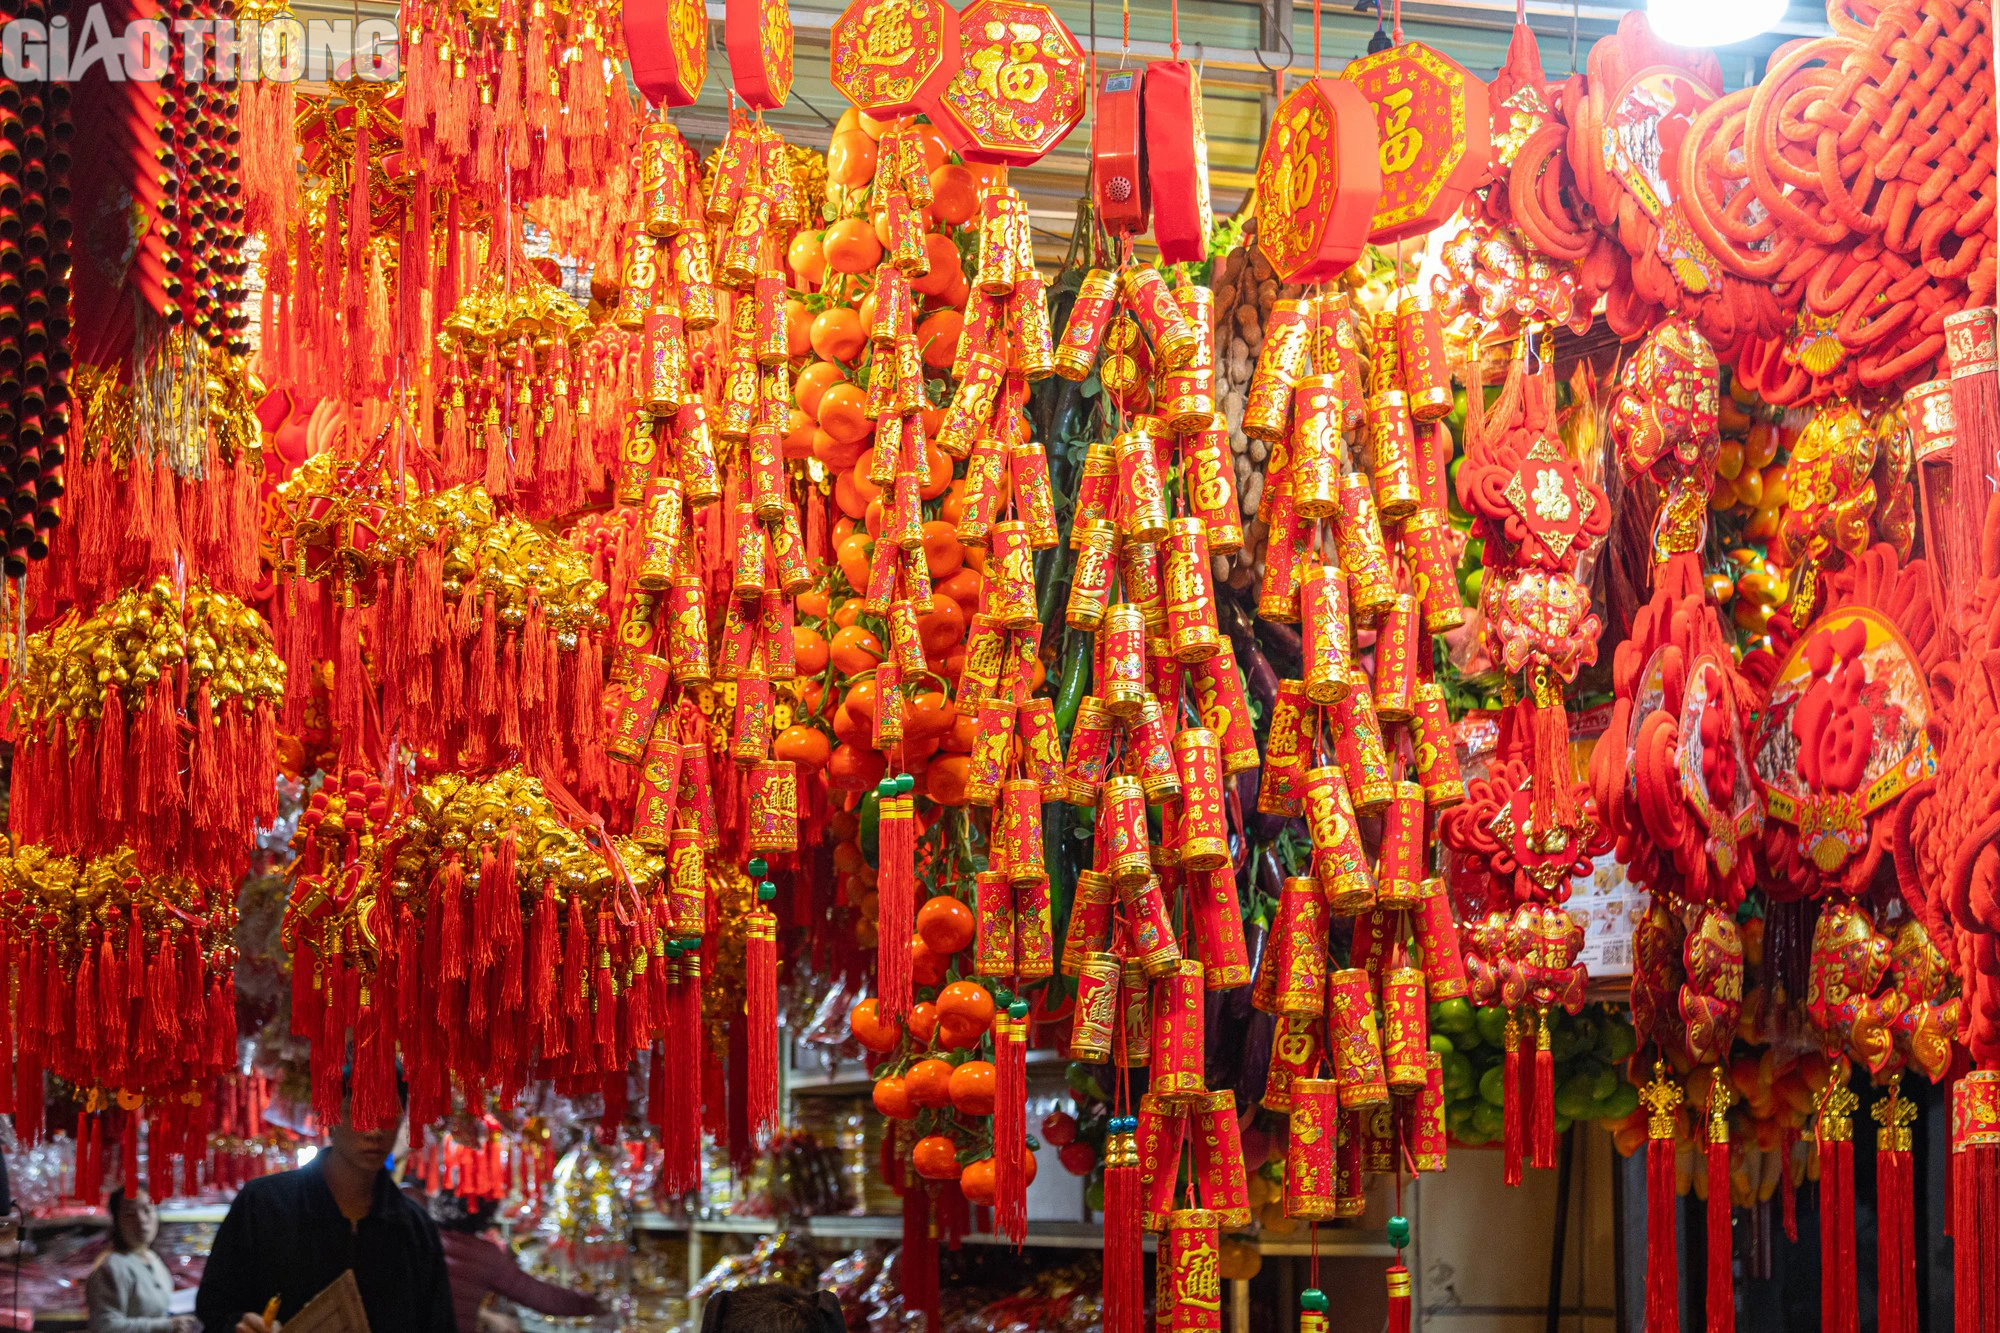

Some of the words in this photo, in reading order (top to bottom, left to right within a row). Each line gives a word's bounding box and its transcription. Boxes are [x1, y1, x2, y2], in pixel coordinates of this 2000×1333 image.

[971, 21, 1048, 104] 福
[1370, 88, 1422, 175] 福
[1274, 106, 1317, 218] 福
[621, 233, 657, 290] 福
[674, 231, 713, 285] 福
[725, 361, 758, 405] 福
[869, 352, 896, 389] 福
[959, 367, 1003, 424] 福
[1185, 446, 1231, 510] 福
[618, 591, 654, 648] 福
[1792, 619, 1873, 795] 福
[1302, 784, 1349, 850] 福
